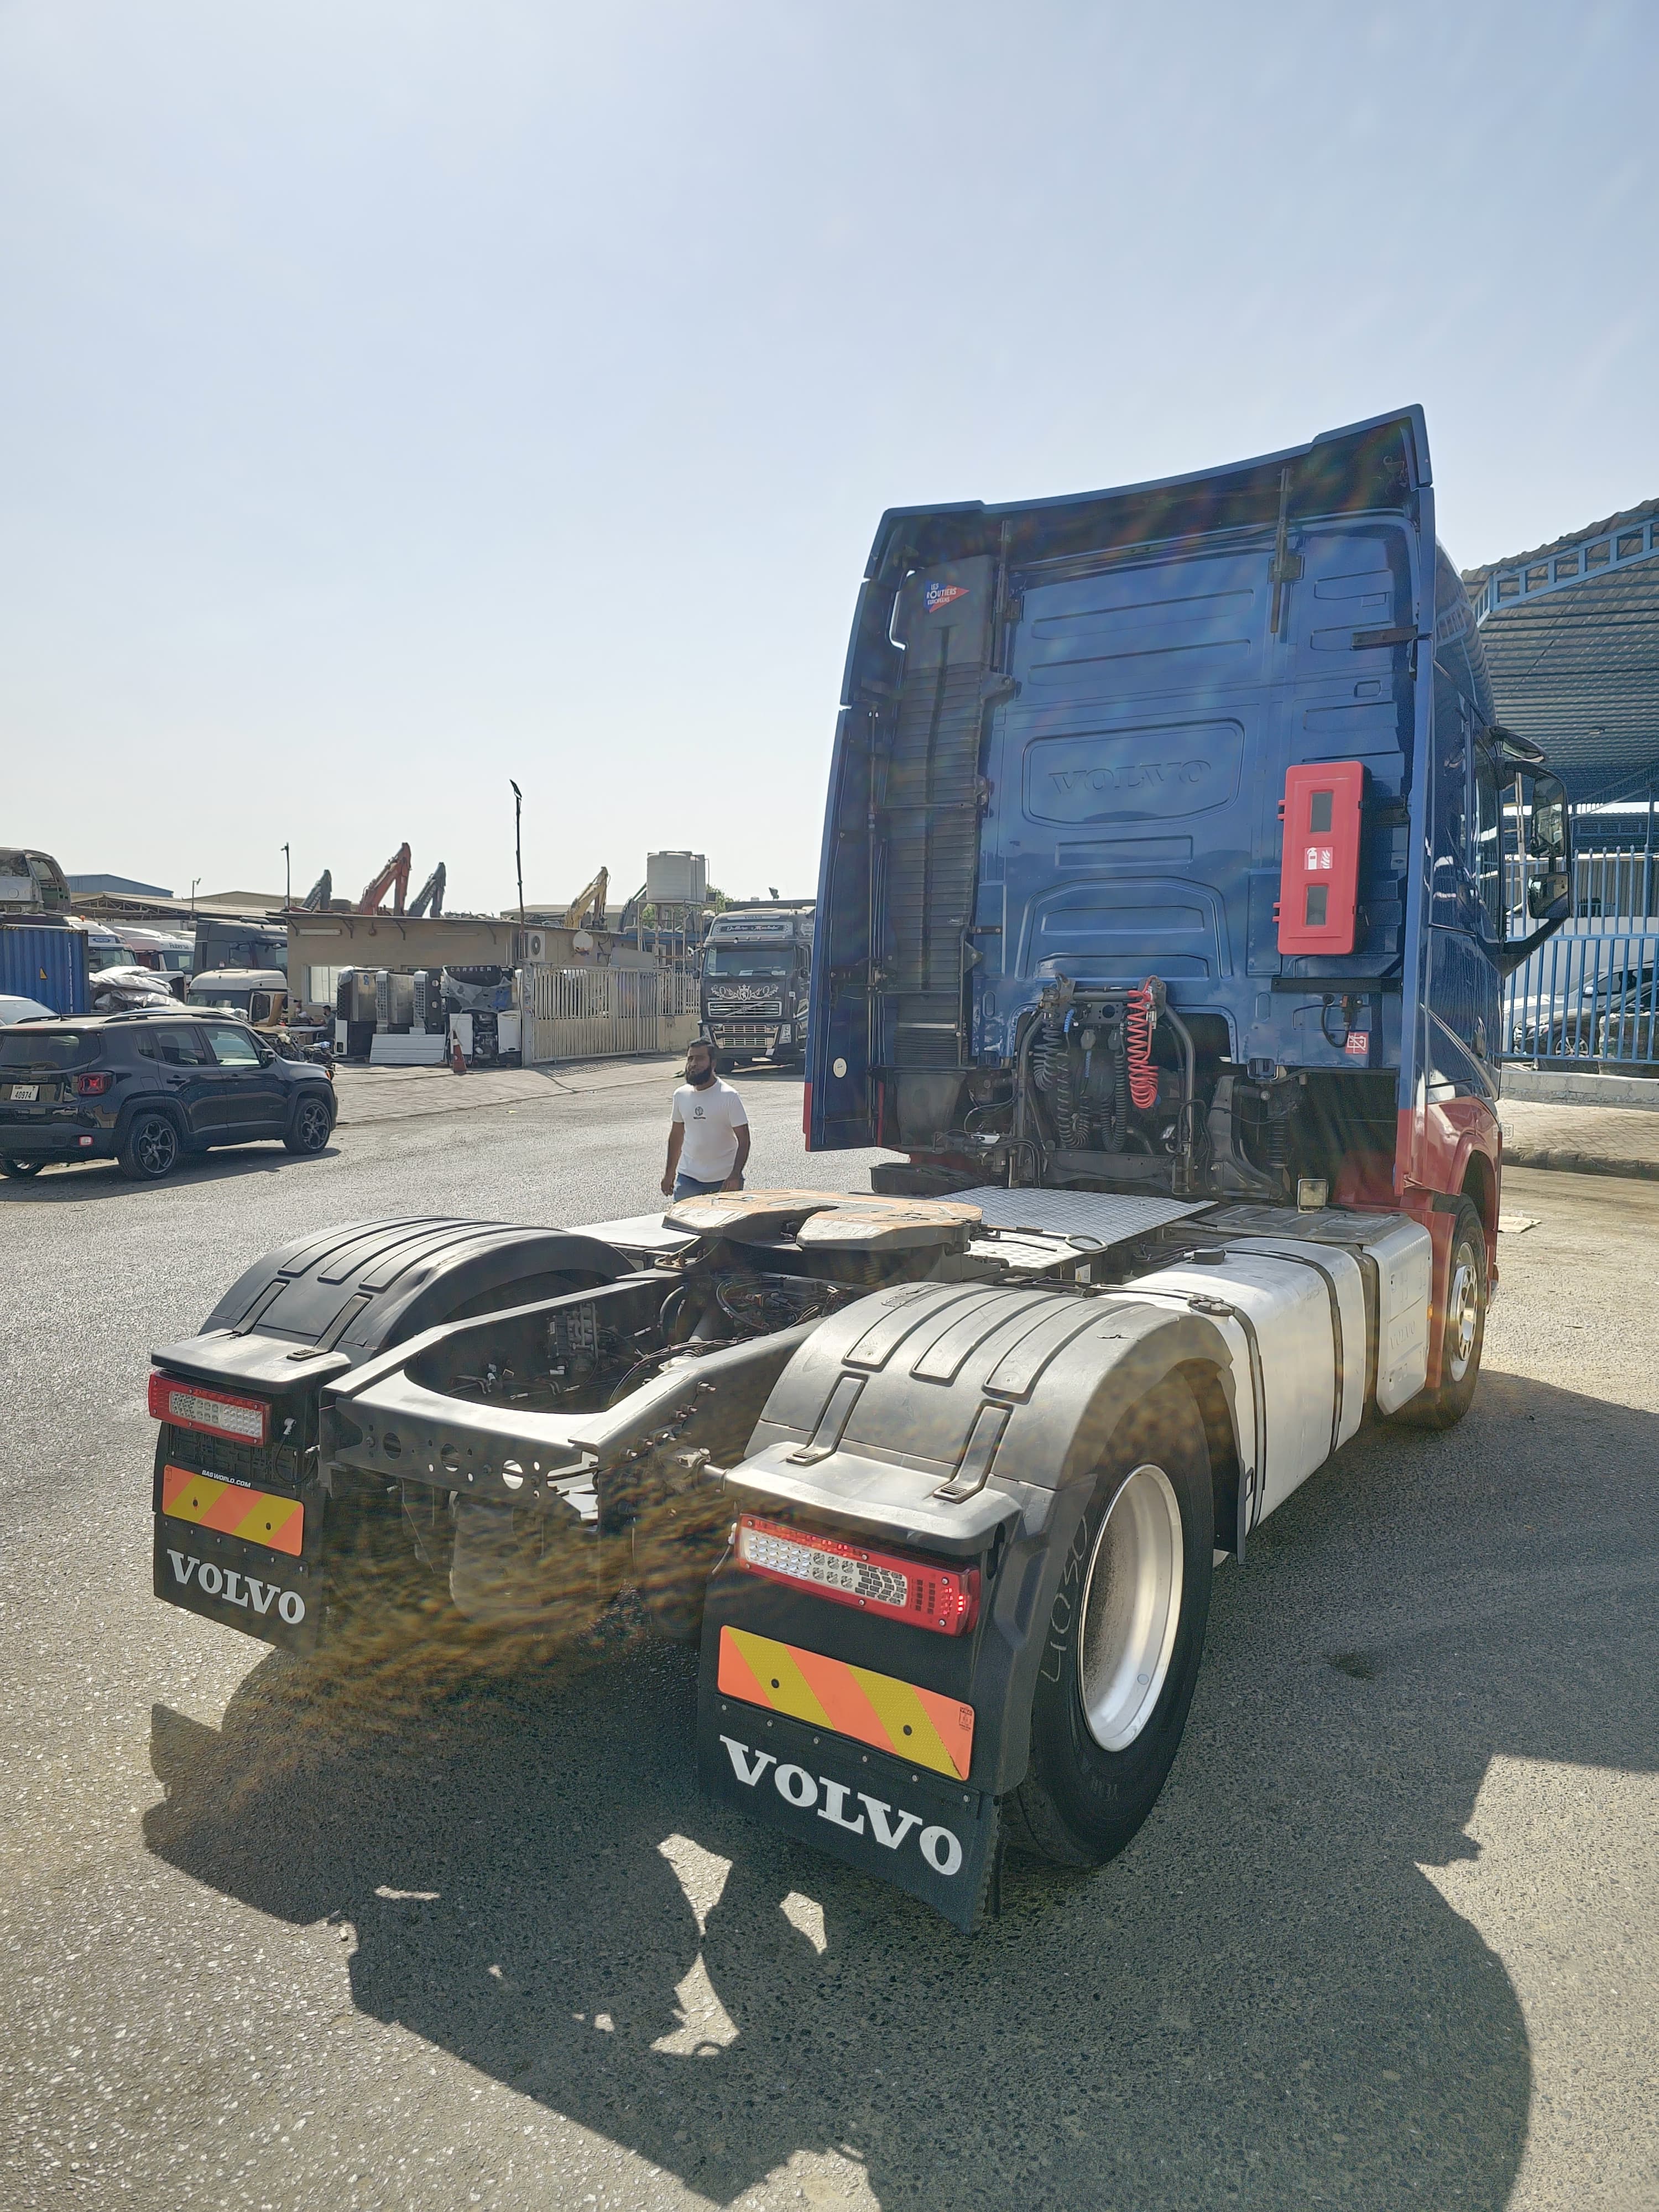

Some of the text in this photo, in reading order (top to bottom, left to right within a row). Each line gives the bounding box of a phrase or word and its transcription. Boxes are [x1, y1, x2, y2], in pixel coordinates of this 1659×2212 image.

[926, 587, 957, 599] ROUTIERS
[1048, 760, 1211, 794] VOLVO
[15, 1091, 32, 1099] 40974
[166, 1548, 306, 1625] VOLVO
[719, 1734, 963, 1876] VOLVO
